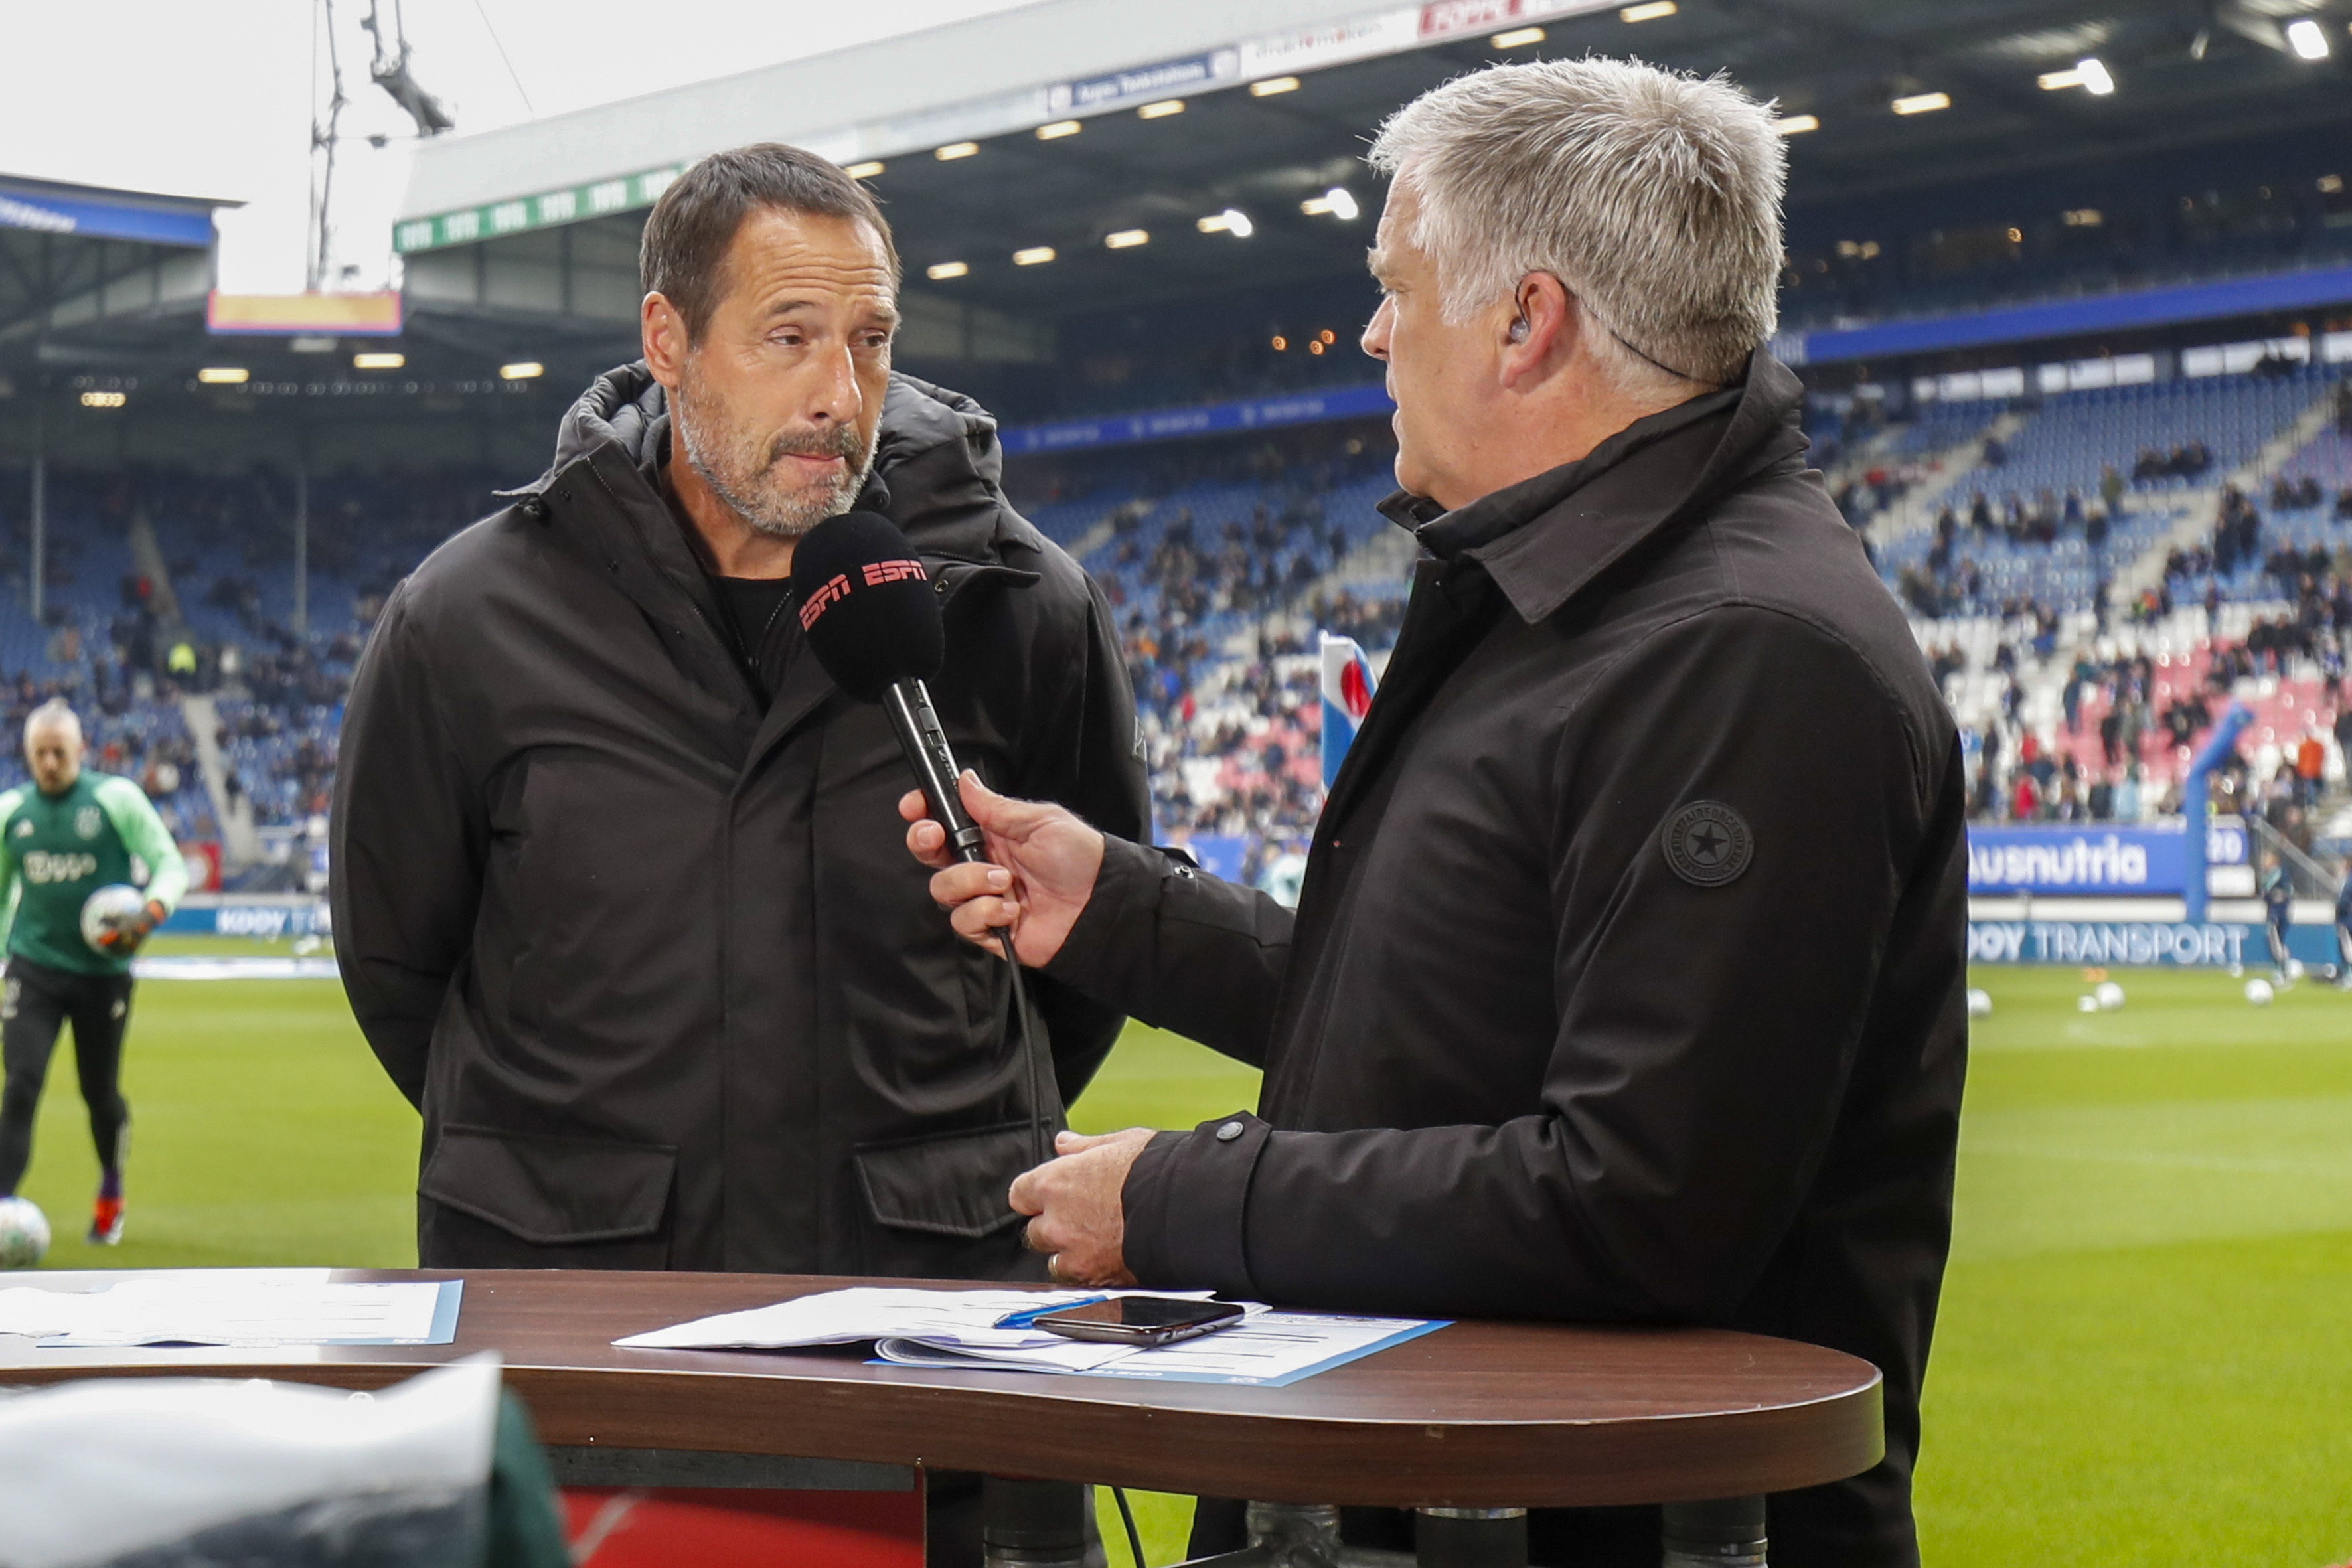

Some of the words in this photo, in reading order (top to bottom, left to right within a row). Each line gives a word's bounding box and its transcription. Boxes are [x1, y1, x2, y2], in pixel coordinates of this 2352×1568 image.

[861, 559, 927, 586] ESPN
[799, 574, 852, 631] ESPN
[2033, 923, 2249, 963] TRANSPORT
